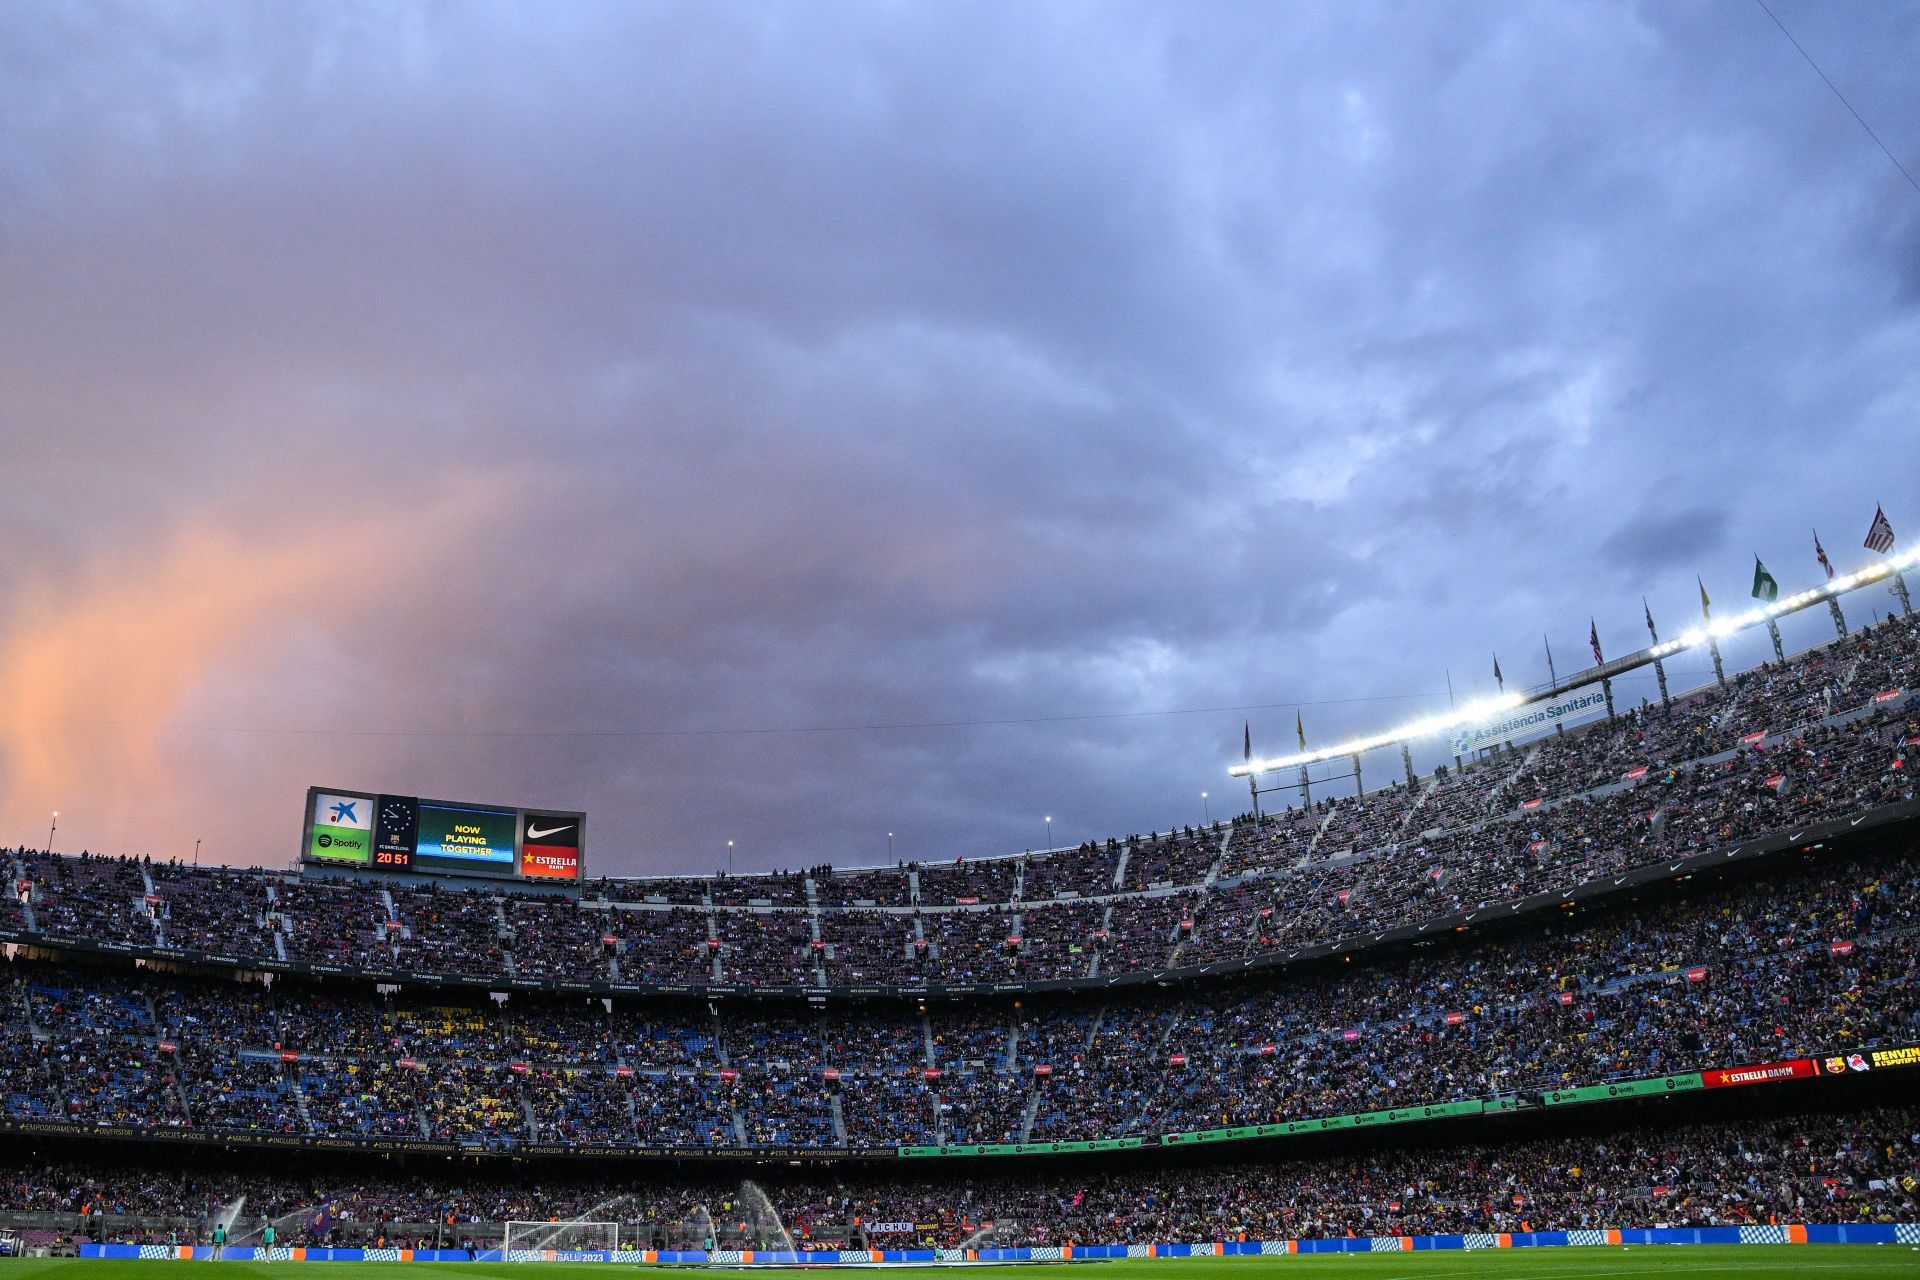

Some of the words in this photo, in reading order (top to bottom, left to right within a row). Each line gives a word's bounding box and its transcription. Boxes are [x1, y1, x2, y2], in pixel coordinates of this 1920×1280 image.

[1546, 693, 1604, 718] Sanitària
[455, 825, 480, 834] NOW
[334, 839, 361, 849] Spotify
[446, 834, 486, 845] PLAYING
[441, 844, 492, 855] TOGETHER
[377, 852, 392, 864] 20
[394, 854, 408, 864] 51
[536, 856, 577, 866] ESTRELLA
[1731, 1070, 1768, 1082] ESTRELLA
[1768, 1067, 1793, 1077] DAMM
[1676, 1078, 1694, 1087] Spotify
